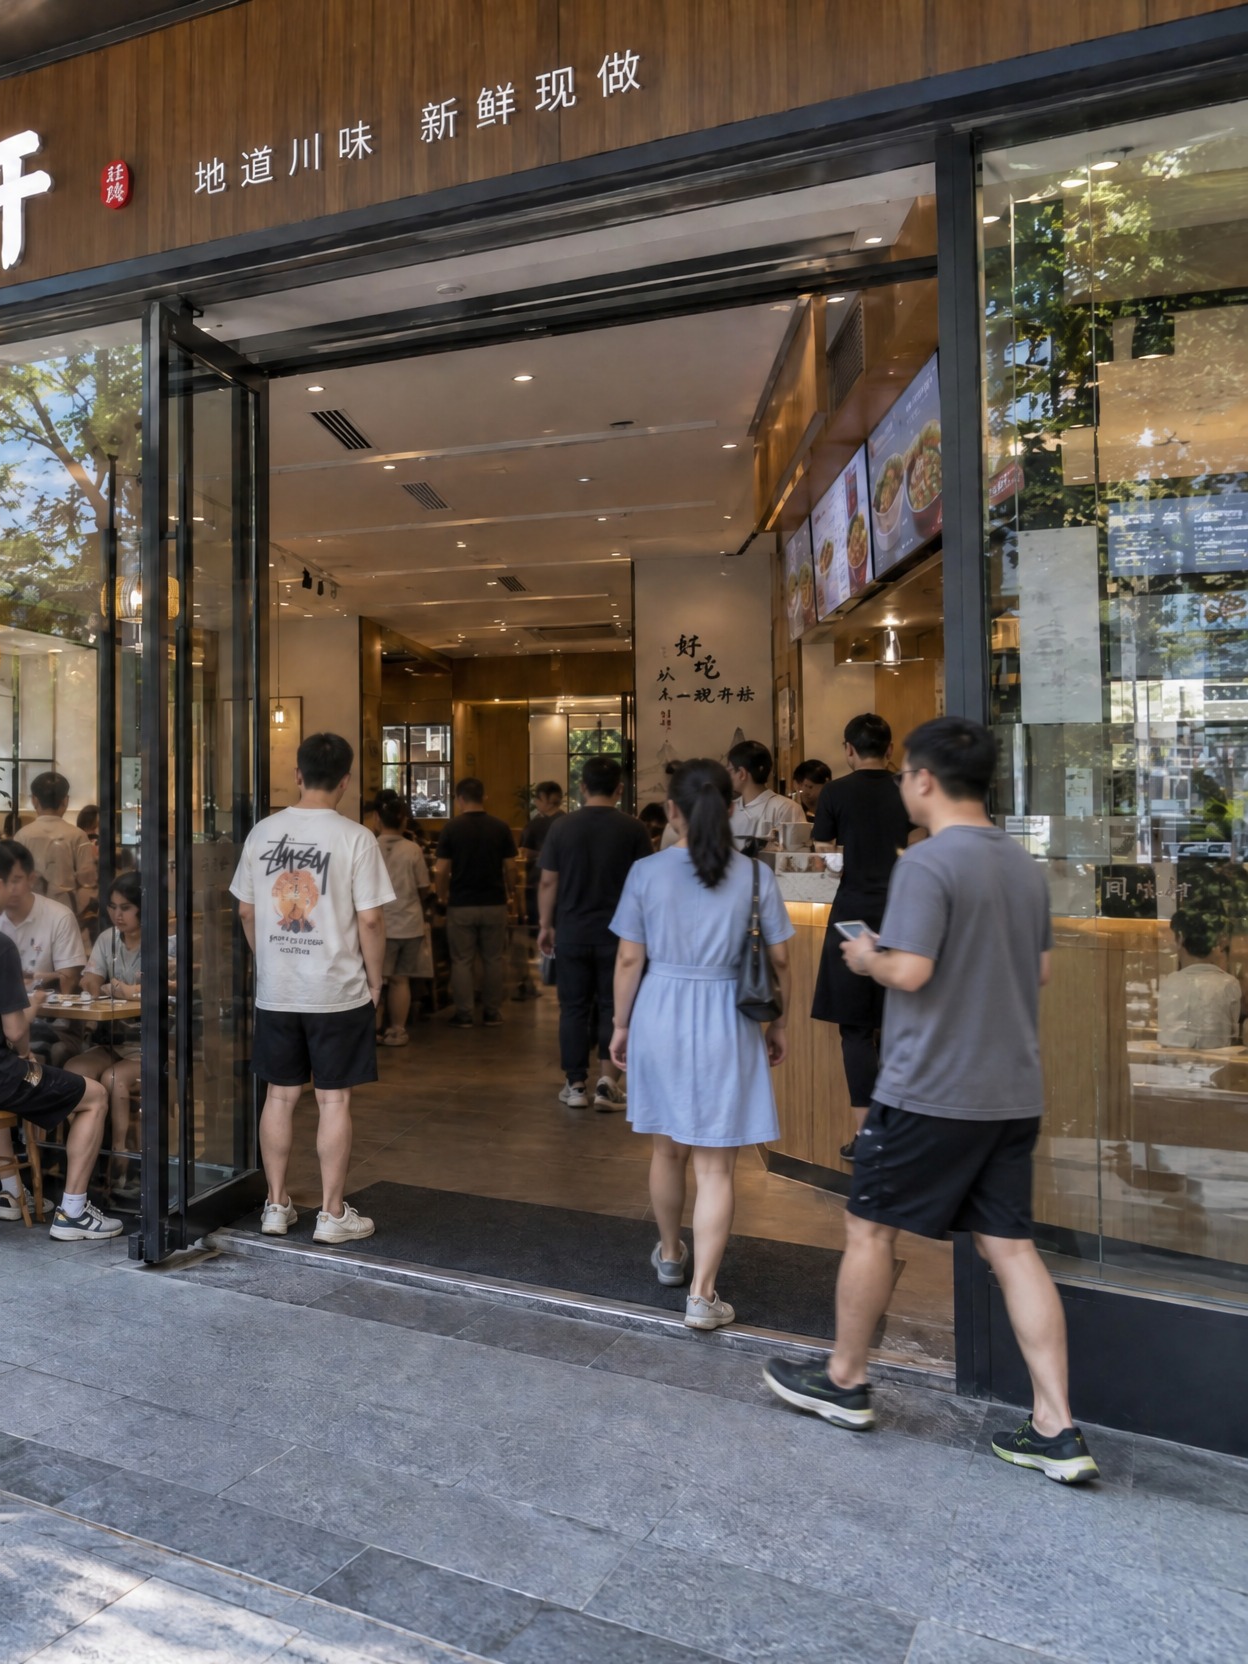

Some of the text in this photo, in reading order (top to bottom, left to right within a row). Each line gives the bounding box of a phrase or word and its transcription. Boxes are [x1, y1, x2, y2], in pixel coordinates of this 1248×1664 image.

[194, 120, 374, 195] 地道川味
[420, 49, 641, 144] 新鲜现做
